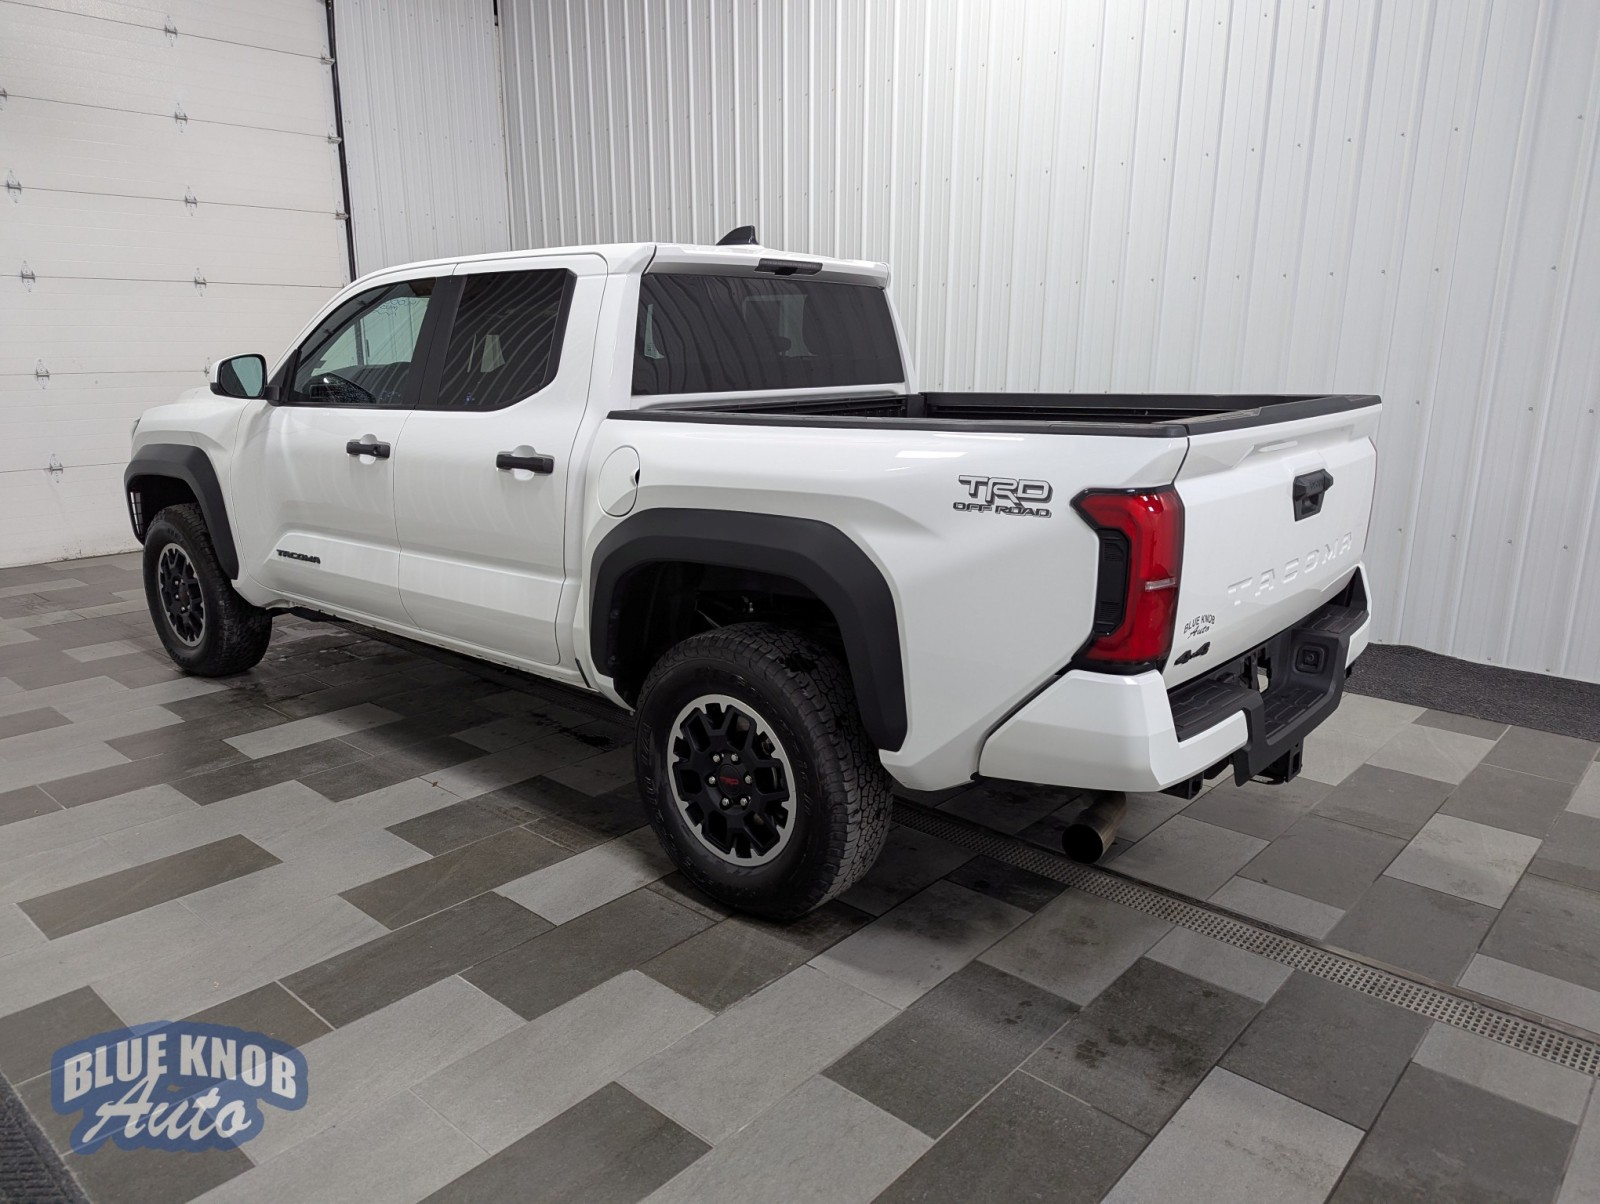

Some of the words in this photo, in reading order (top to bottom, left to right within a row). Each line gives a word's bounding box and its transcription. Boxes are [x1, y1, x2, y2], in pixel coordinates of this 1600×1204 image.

[958, 475, 1053, 506] TRD
[953, 501, 992, 514] OFF
[995, 505, 1052, 518] ROAD
[276, 548, 321, 565] TACOMA
[1227, 532, 1352, 606] TACOMA
[1183, 615, 1200, 634] BLUE
